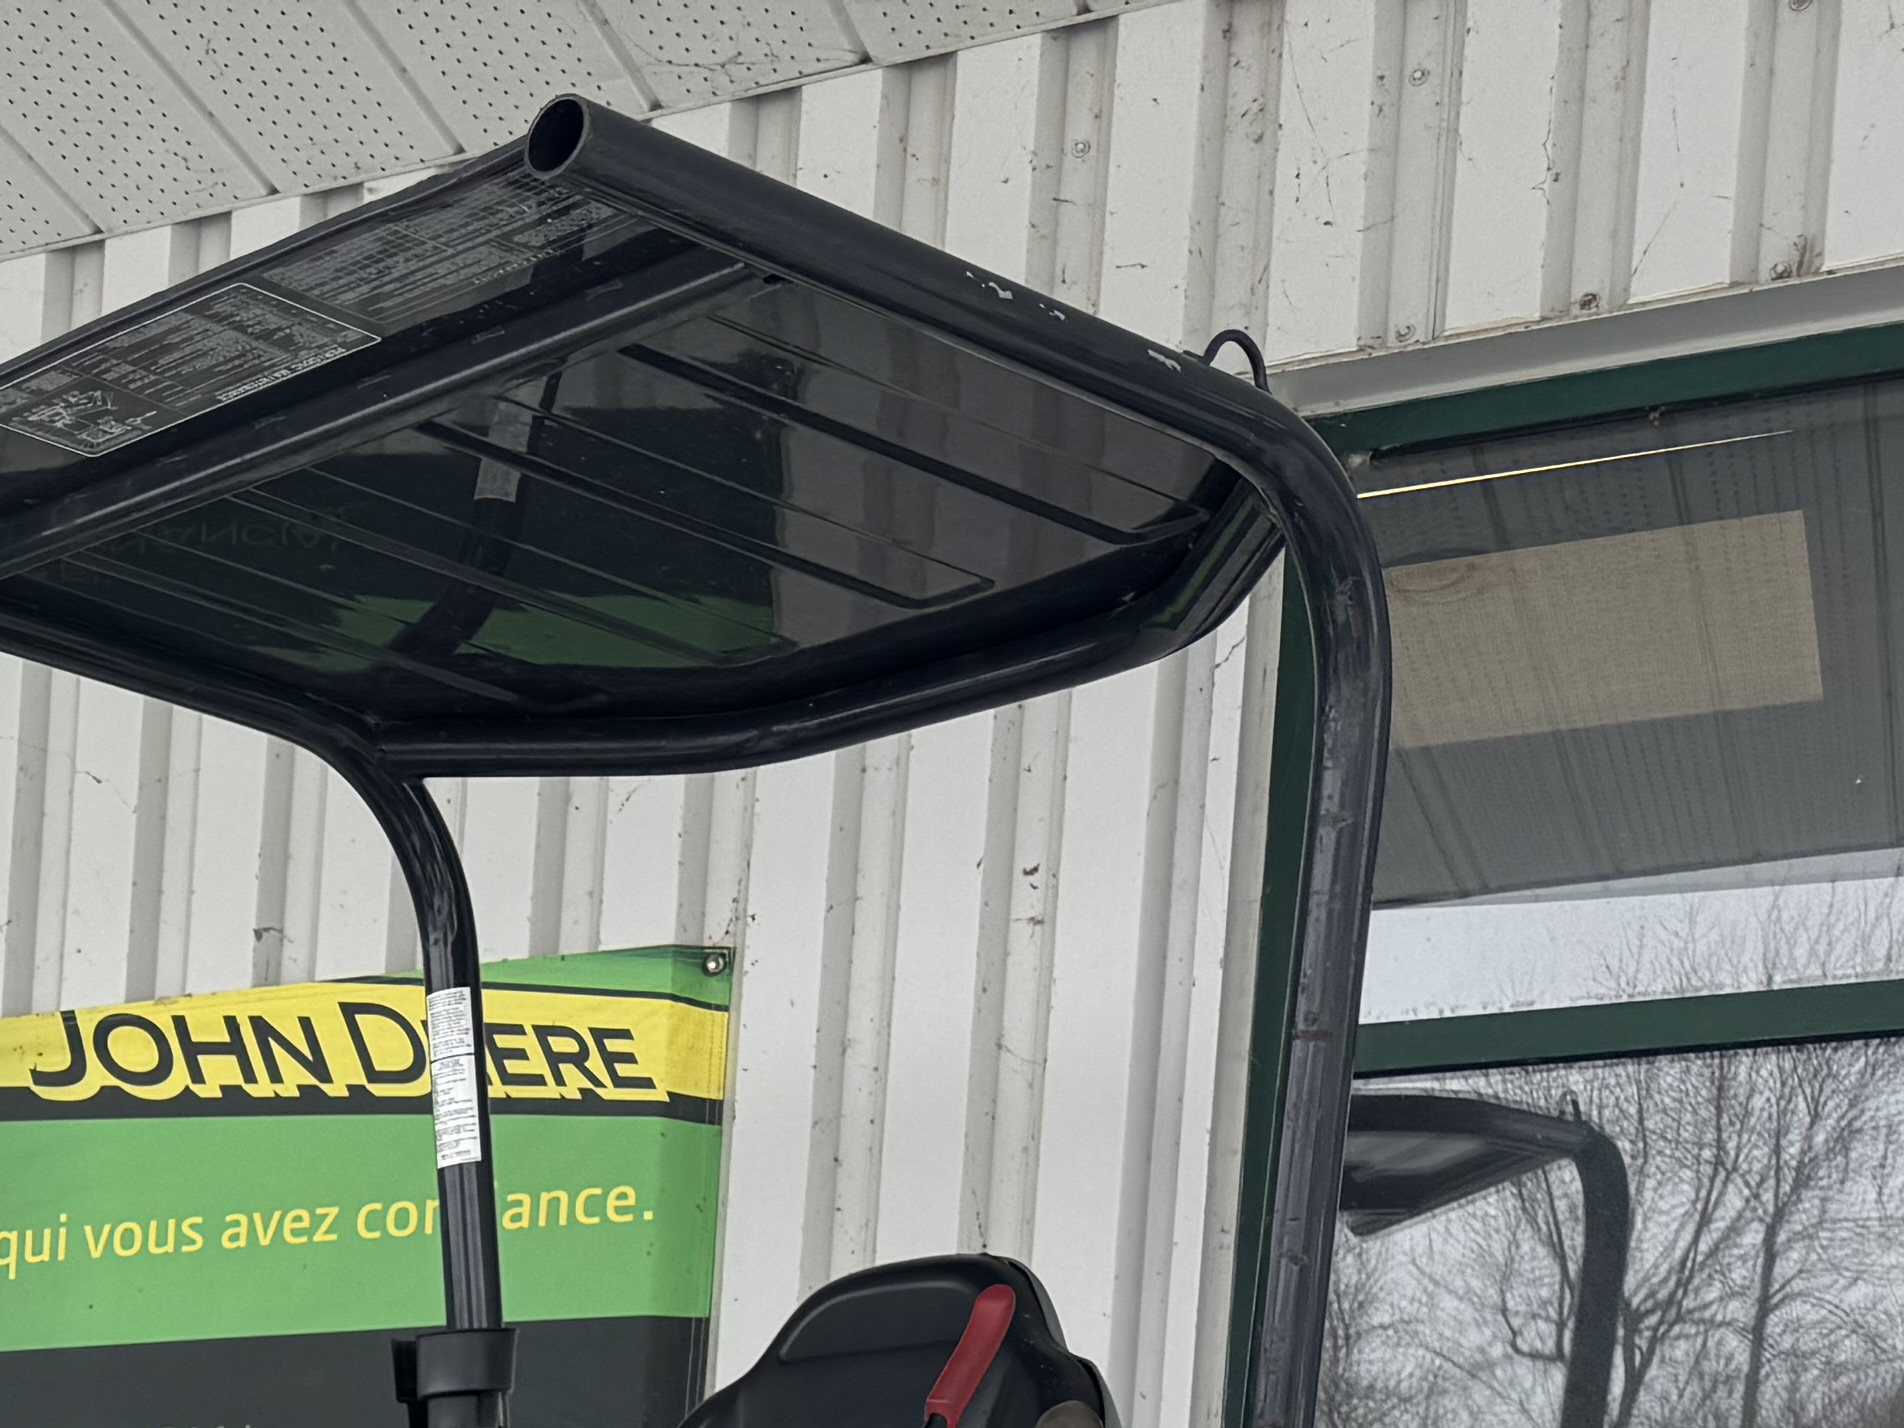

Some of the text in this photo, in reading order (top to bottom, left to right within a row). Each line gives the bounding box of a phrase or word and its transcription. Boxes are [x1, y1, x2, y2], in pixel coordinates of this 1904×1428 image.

[30, 1010, 334, 1088] JOHN
[339, 1002, 655, 1089] DERE
[84, 1213, 204, 1259] vous
[220, 1205, 339, 1250] avez
[356, 1185, 654, 1240] coance.
